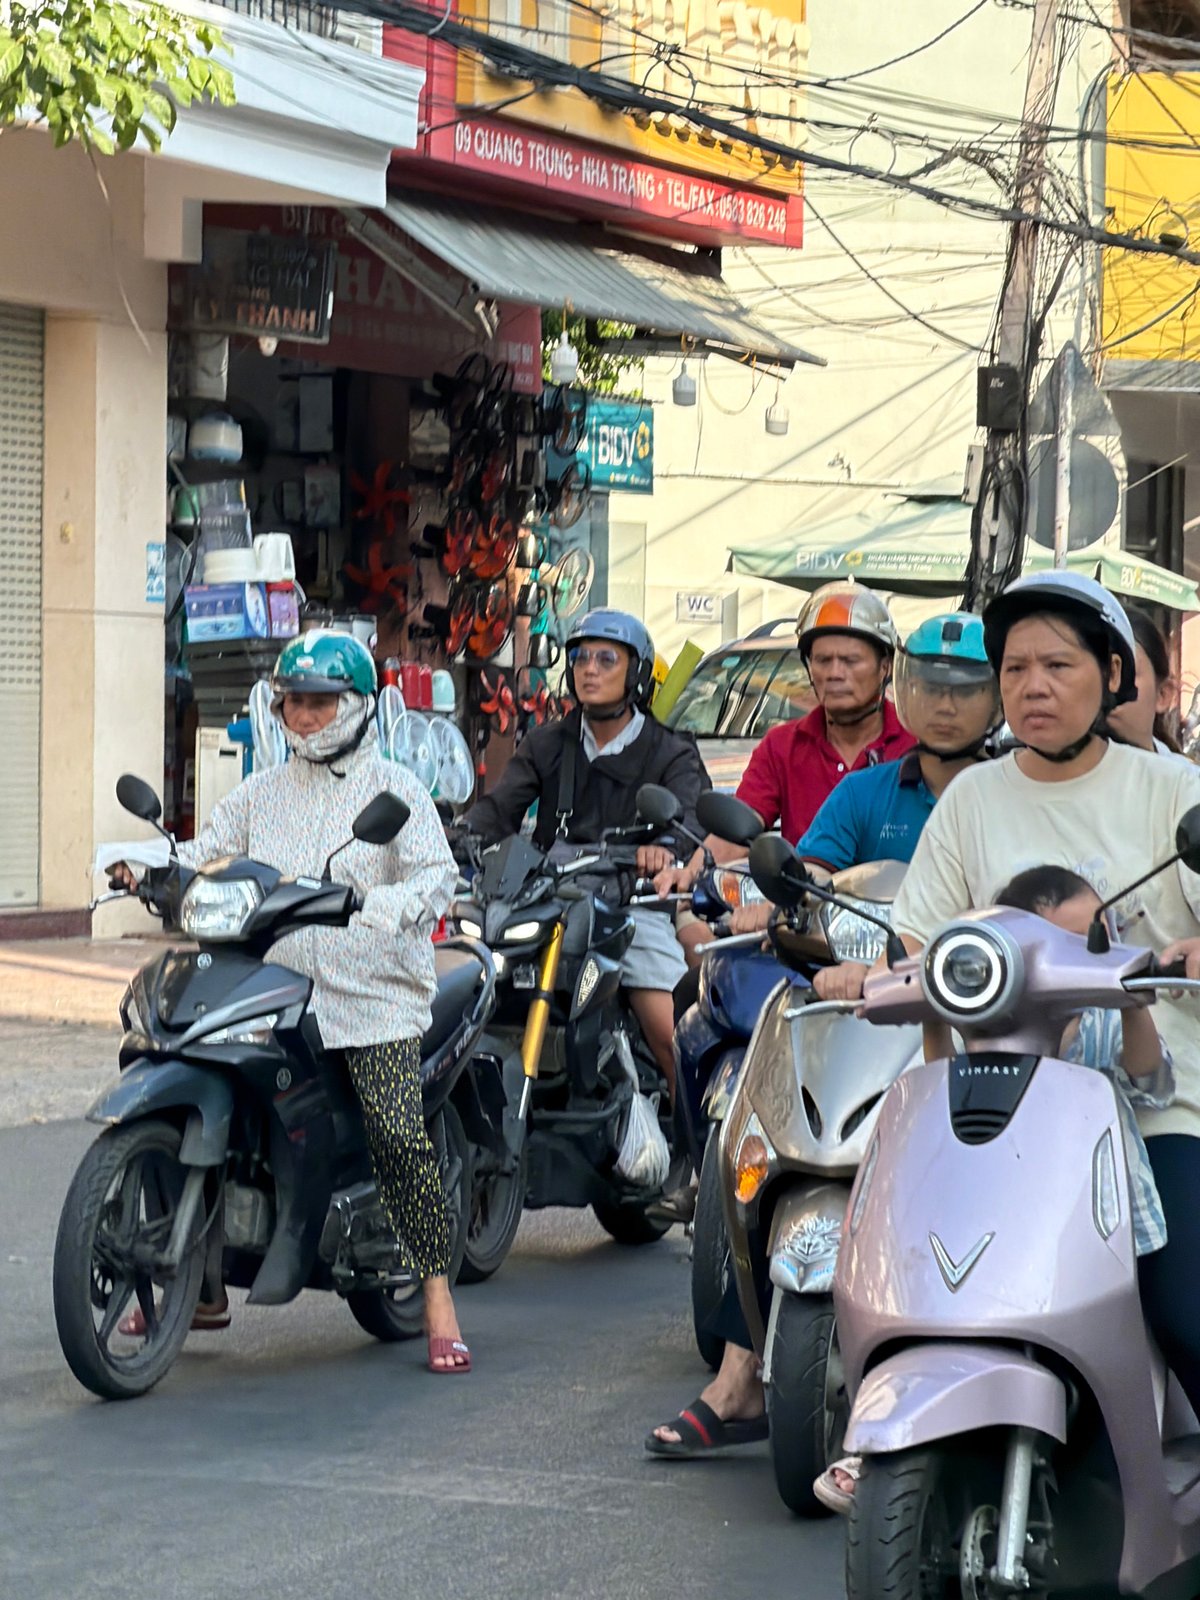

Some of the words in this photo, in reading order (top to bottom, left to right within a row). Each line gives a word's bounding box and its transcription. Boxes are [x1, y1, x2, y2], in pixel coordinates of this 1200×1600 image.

[455, 122, 471, 152] 09
[475, 128, 523, 167] QUANG
[528, 141, 572, 180] TRUNG
[581, 156, 609, 189] NHA
[612, 163, 655, 201] TRANG
[599, 425, 637, 468] BIDV
[796, 552, 846, 570] BIDV
[687, 596, 714, 612] WC
[959, 1066, 1020, 1077] VINFAST
